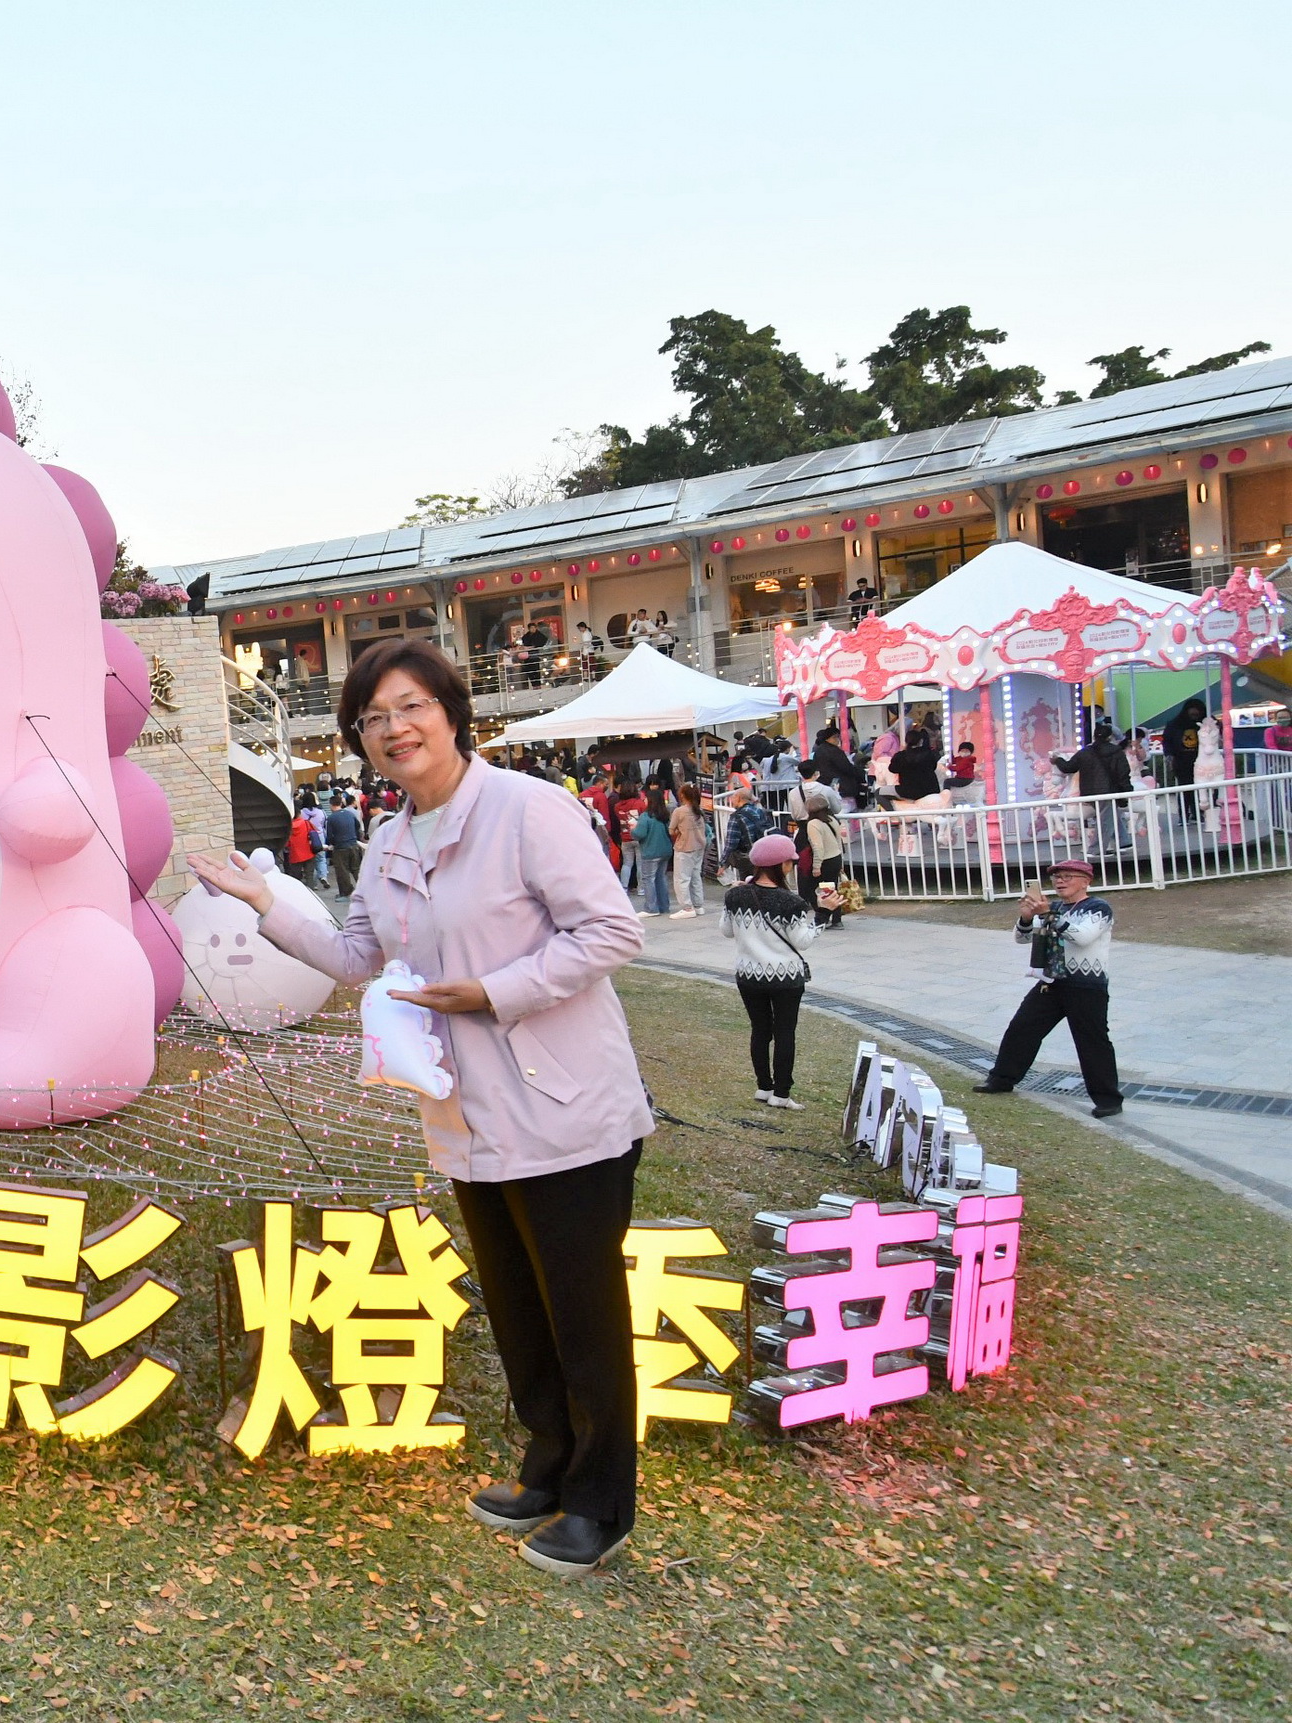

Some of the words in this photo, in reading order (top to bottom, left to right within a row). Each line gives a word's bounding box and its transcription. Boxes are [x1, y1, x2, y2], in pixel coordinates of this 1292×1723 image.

[730, 573, 758, 583] DENKI
[759, 566, 795, 578] COFFEE
[778, 1194, 1024, 1429] 幸福
